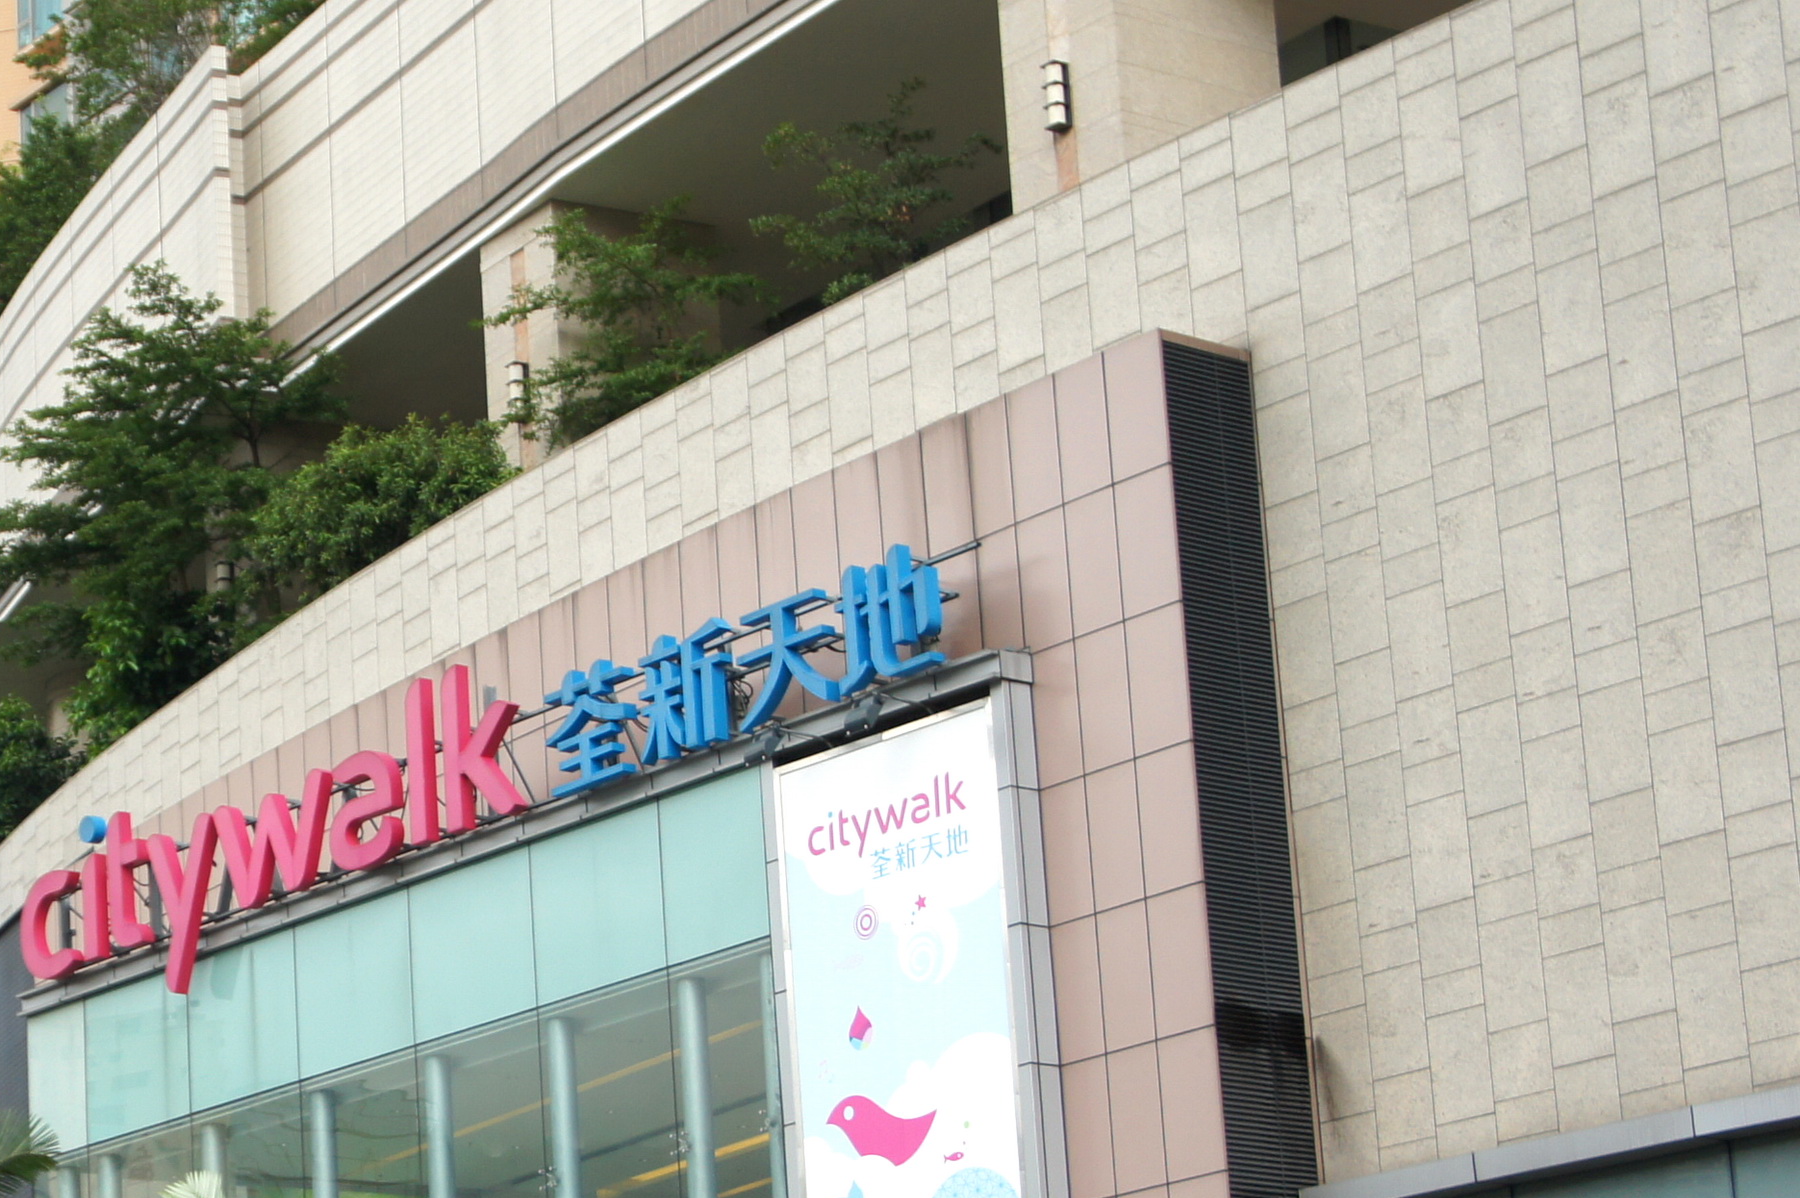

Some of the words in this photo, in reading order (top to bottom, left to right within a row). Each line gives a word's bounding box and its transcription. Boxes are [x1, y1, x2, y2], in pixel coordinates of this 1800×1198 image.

[544, 543, 947, 800] 荃新天地
[20, 664, 530, 994] citywalk
[808, 771, 967, 858] citywalk
[870, 824, 968, 880] 荃新天地
